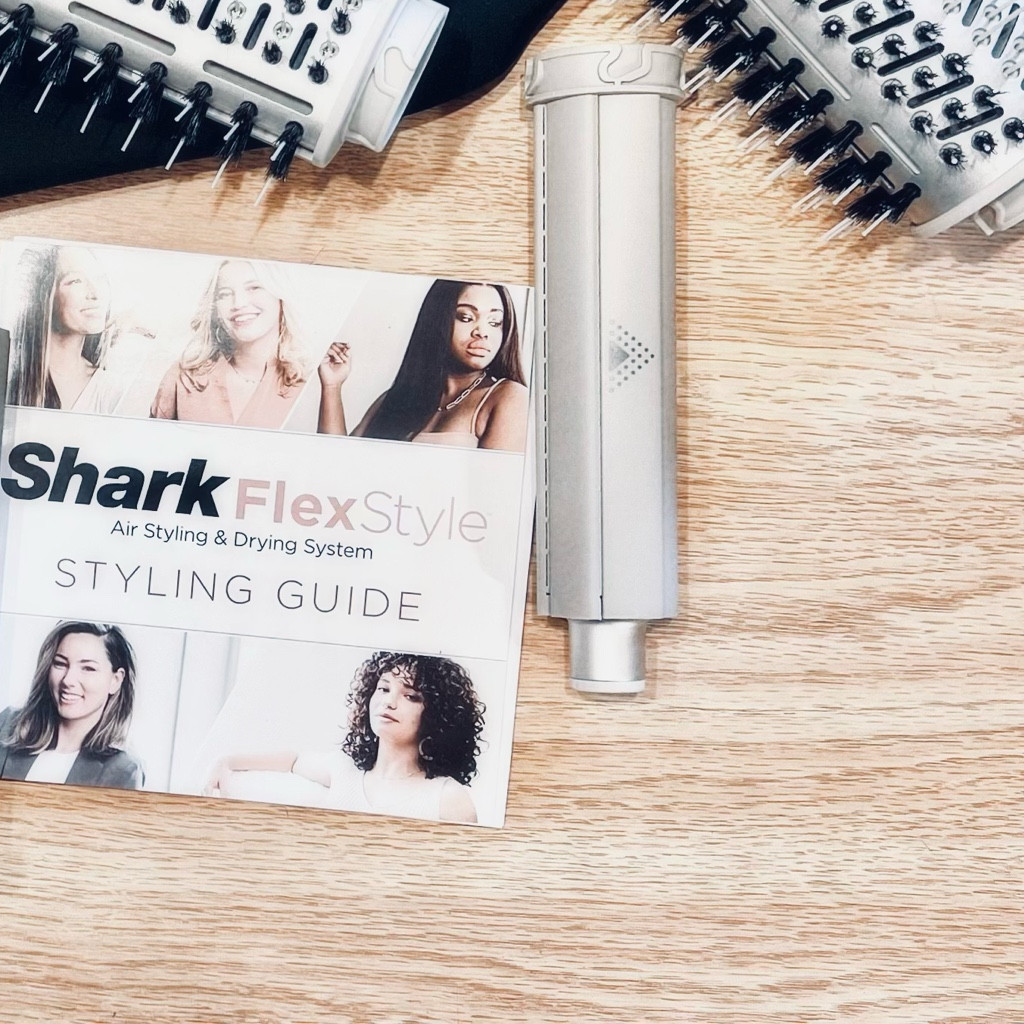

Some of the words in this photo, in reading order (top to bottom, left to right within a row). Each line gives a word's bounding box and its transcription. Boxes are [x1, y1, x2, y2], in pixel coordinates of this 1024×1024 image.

[1, 441, 231, 518] Shark
[234, 478, 489, 548] FlexStyle
[110, 520, 139, 539] Air
[144, 521, 209, 546] Styling
[214, 530, 229, 547] &
[233, 532, 298, 555] Drying
[303, 537, 374, 561] System
[54, 557, 253, 606] STYLING
[276, 579, 423, 623] GUIDE
